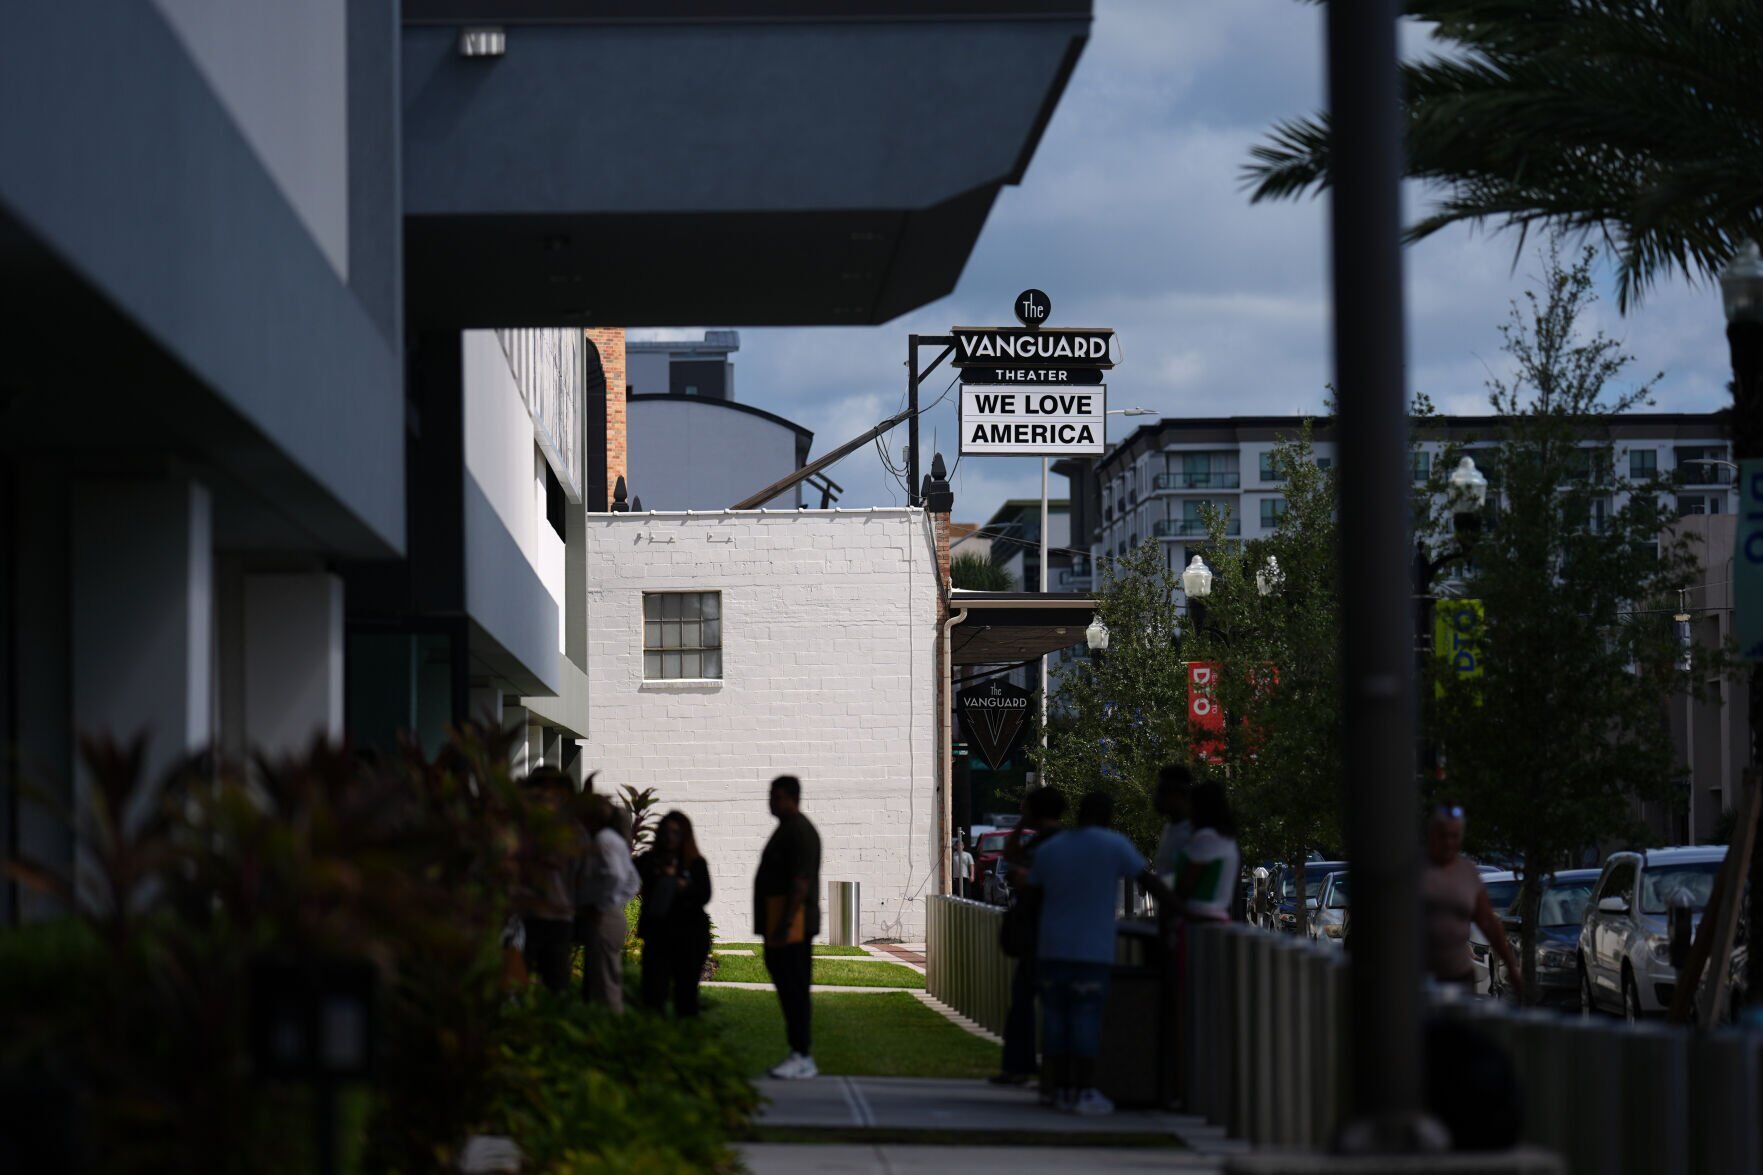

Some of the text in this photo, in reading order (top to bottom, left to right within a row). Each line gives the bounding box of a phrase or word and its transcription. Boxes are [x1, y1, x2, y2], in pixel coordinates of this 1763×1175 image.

[1023, 293, 1044, 318] The
[960, 334, 1106, 358] VANGUARD
[995, 370, 1068, 381] THEATER
[975, 395, 1092, 414] WE LOVE
[971, 424, 1095, 444] AMERICA
[990, 682, 1002, 696] The
[963, 697, 1028, 708] VANGUARD
